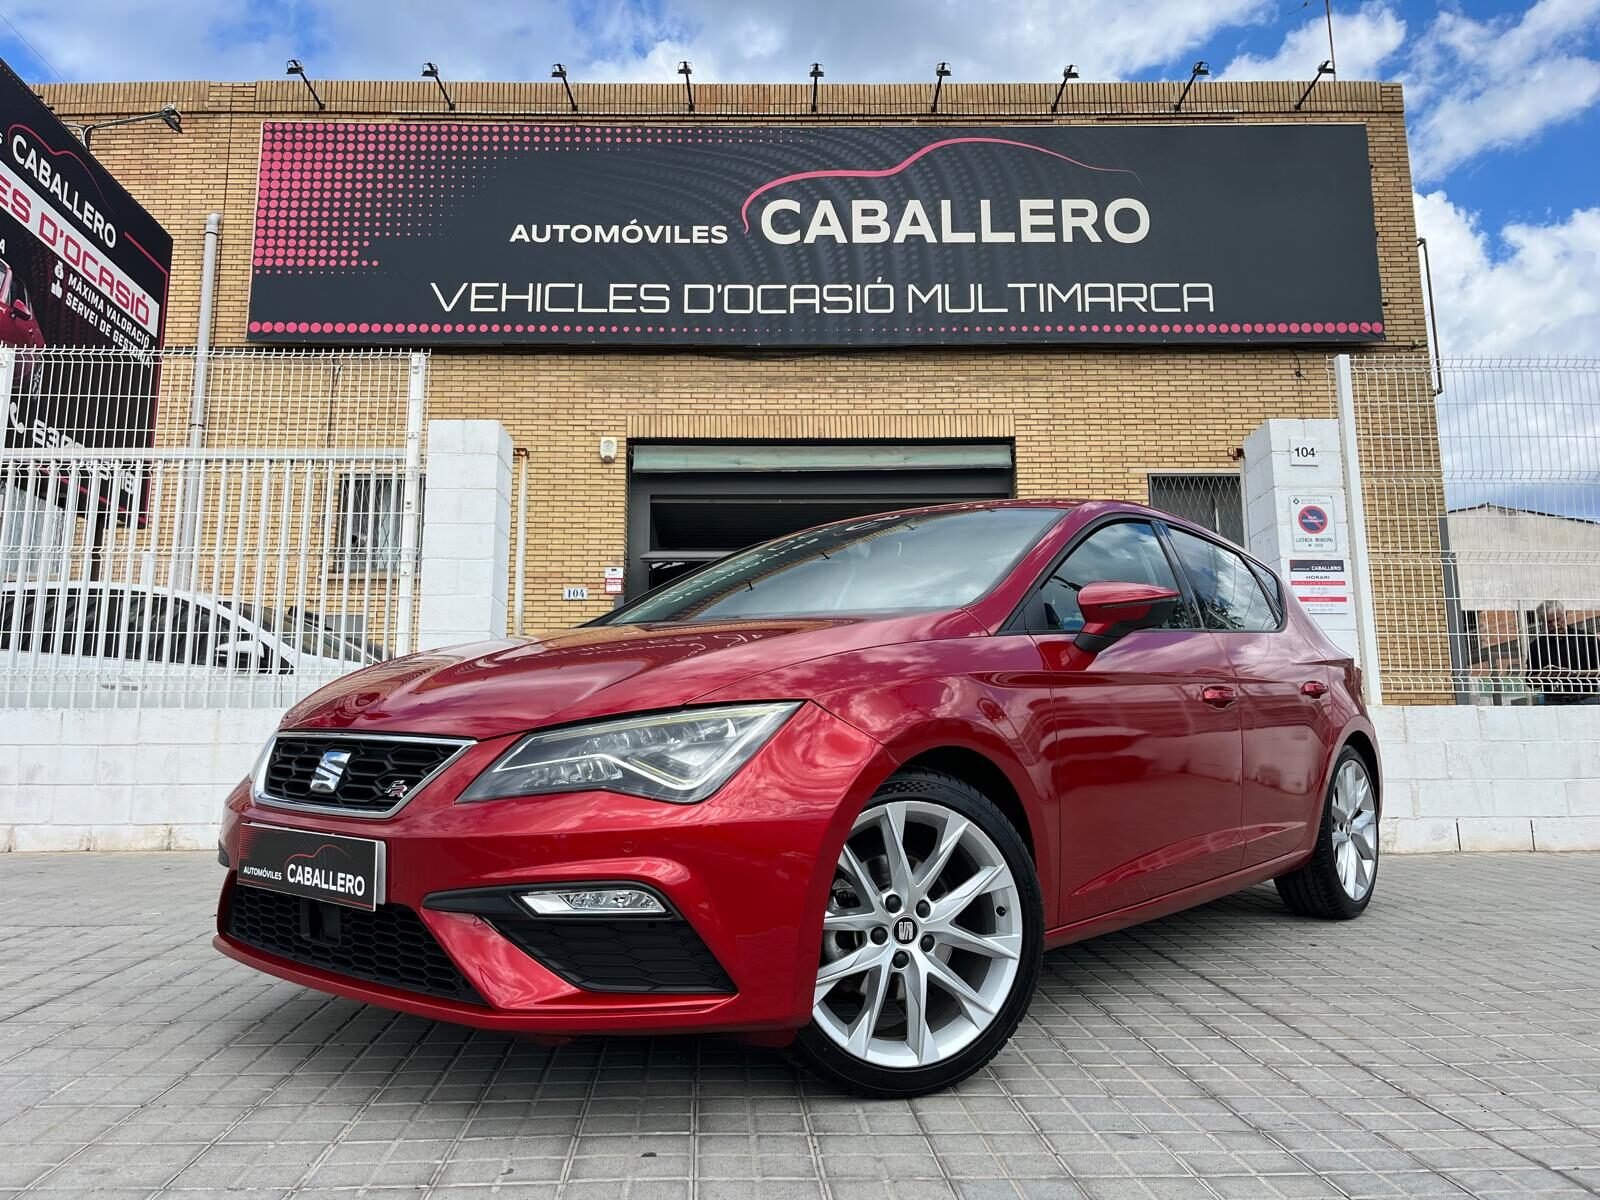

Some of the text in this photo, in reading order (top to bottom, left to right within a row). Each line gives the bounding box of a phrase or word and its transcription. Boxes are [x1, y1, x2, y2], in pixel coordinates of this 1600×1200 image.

[12, 134, 116, 248] CABALLERO
[509, 198, 1151, 244] AUTOMÓVILES CABALLERO
[39, 212, 149, 326] D'OCASIÓ
[65, 293, 99, 327] SERVEI
[100, 318, 112, 337] DE
[430, 276, 1215, 314] VEHICLES D'OCASIÓ MULTIMARCA
[107, 304, 150, 349] VALORACIÓ
[1294, 446, 1316, 458] 104
[567, 589, 585, 598] 104
[243, 863, 366, 897] AUTOMÓVILES CABALLERO
